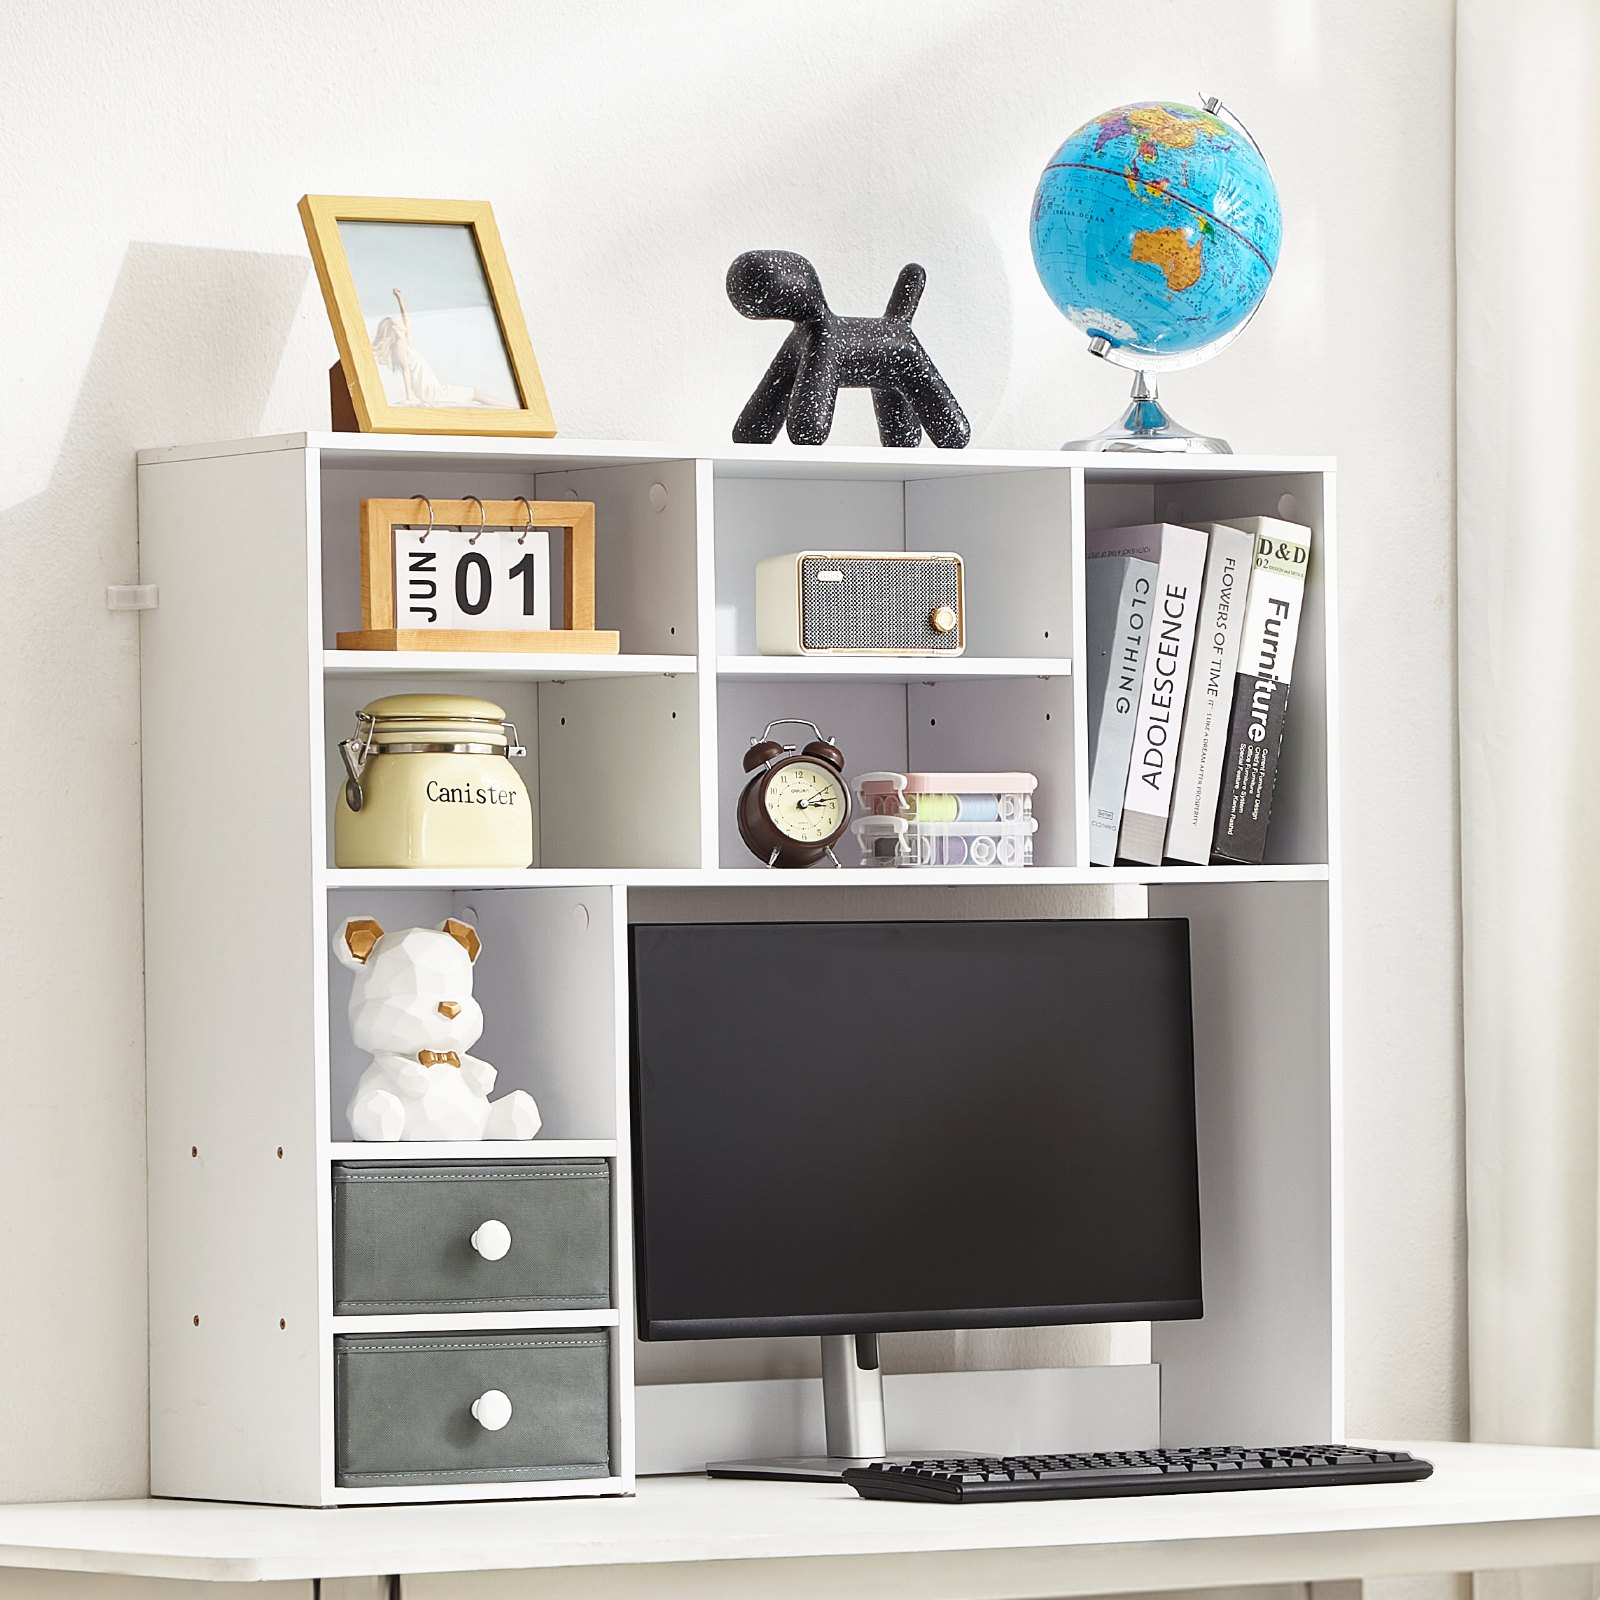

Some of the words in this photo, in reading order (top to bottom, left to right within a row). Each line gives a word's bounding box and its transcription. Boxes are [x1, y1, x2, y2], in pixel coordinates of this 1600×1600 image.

[1256, 557, 1269, 568] 02
[409, 552, 437, 622] JUN
[1215, 557, 1236, 630] FLOWERS
[1116, 578, 1150, 714] CLOTHING
[1213, 632, 1226, 656] OF
[1206, 659, 1222, 697] TIME
[1248, 598, 1290, 742] Furniture
[1142, 584, 1187, 790] ADOLESCENCE
[1200, 738, 1208, 764] DREAM
[1238, 743, 1246, 766] Special
[1246, 744, 1254, 762] Office
[1260, 748, 1268, 772] Current
[780, 776, 788, 784] 11
[794, 770, 804, 779] 12
[1234, 766, 1244, 790] Feature
[1242, 764, 1251, 790] Furniture
[1249, 768, 1258, 794] Furniture
[1256, 772, 1266, 798] Furniture
[426, 780, 517, 805] Canister
[770, 787, 778, 795] 10
[830, 802, 836, 810] 3
[1192, 786, 1202, 826] PROSPERITY
[1252, 799, 1260, 820] Design
[817, 828, 822, 836] 5
[1228, 813, 1236, 836] Rashid
